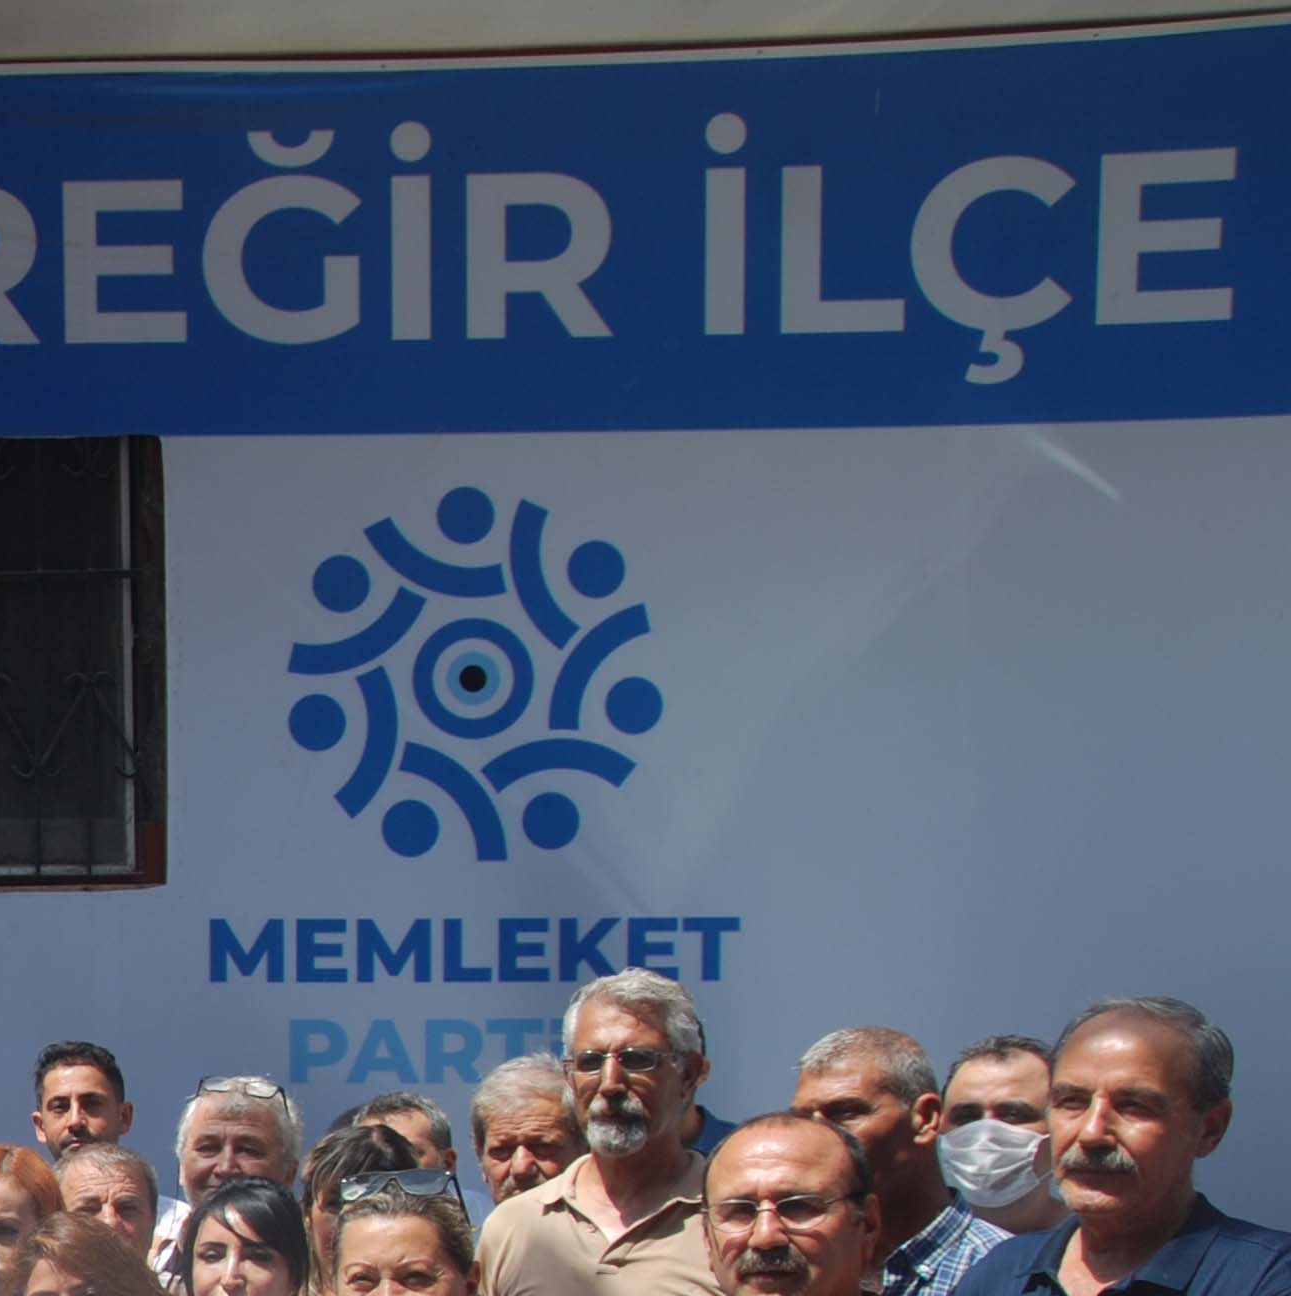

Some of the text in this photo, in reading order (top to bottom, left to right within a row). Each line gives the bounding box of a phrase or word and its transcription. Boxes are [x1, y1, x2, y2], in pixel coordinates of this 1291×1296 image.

[705, 113, 1238, 385] İLÇE
[209, 917, 741, 983] MEMLEKET
[288, 1017, 563, 1085] PART
